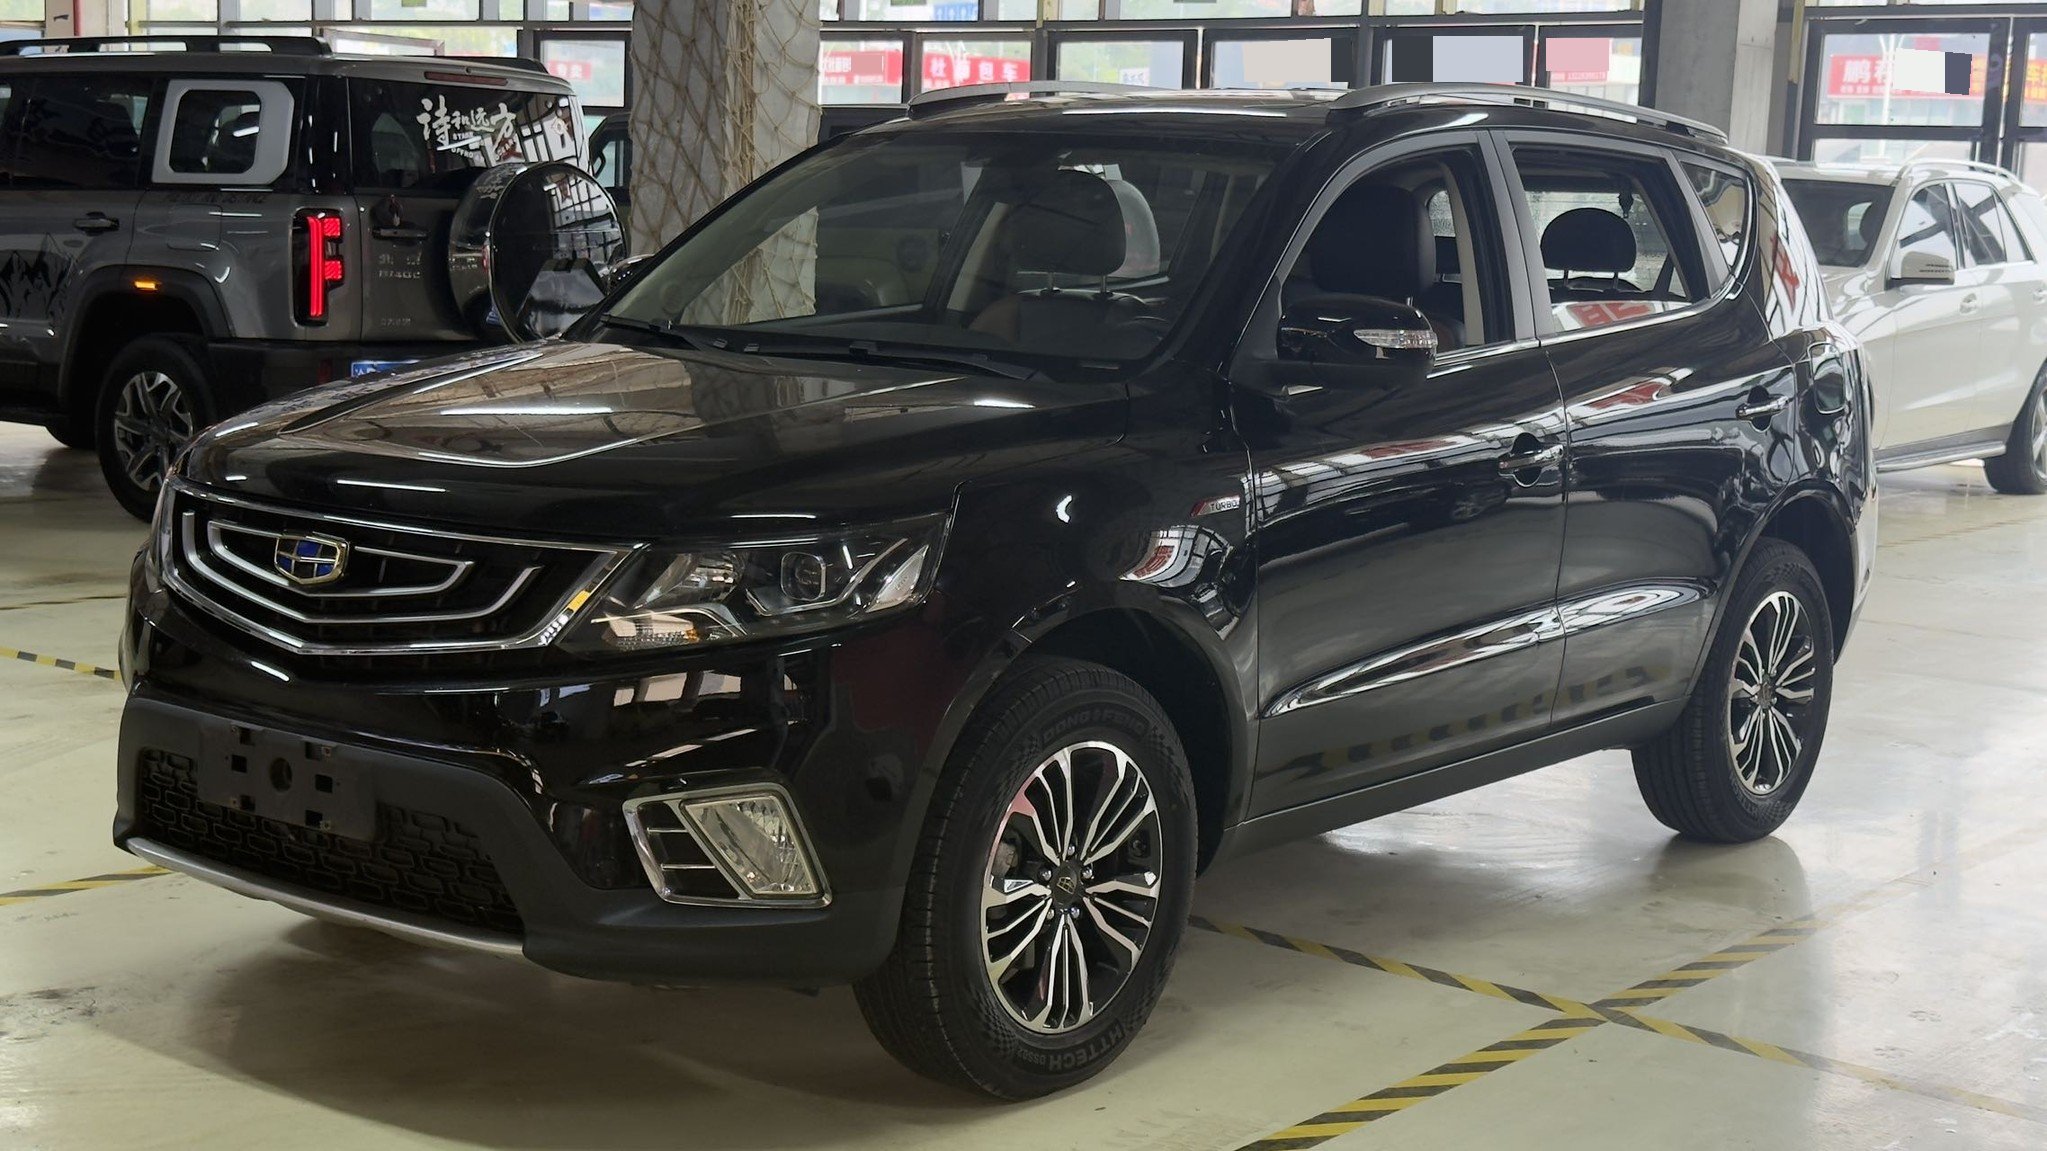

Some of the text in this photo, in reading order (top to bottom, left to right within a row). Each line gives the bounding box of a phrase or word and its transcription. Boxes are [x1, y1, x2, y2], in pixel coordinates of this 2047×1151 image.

[416, 94, 517, 153] 诗和远方
[1210, 500, 1238, 511] TURBO
